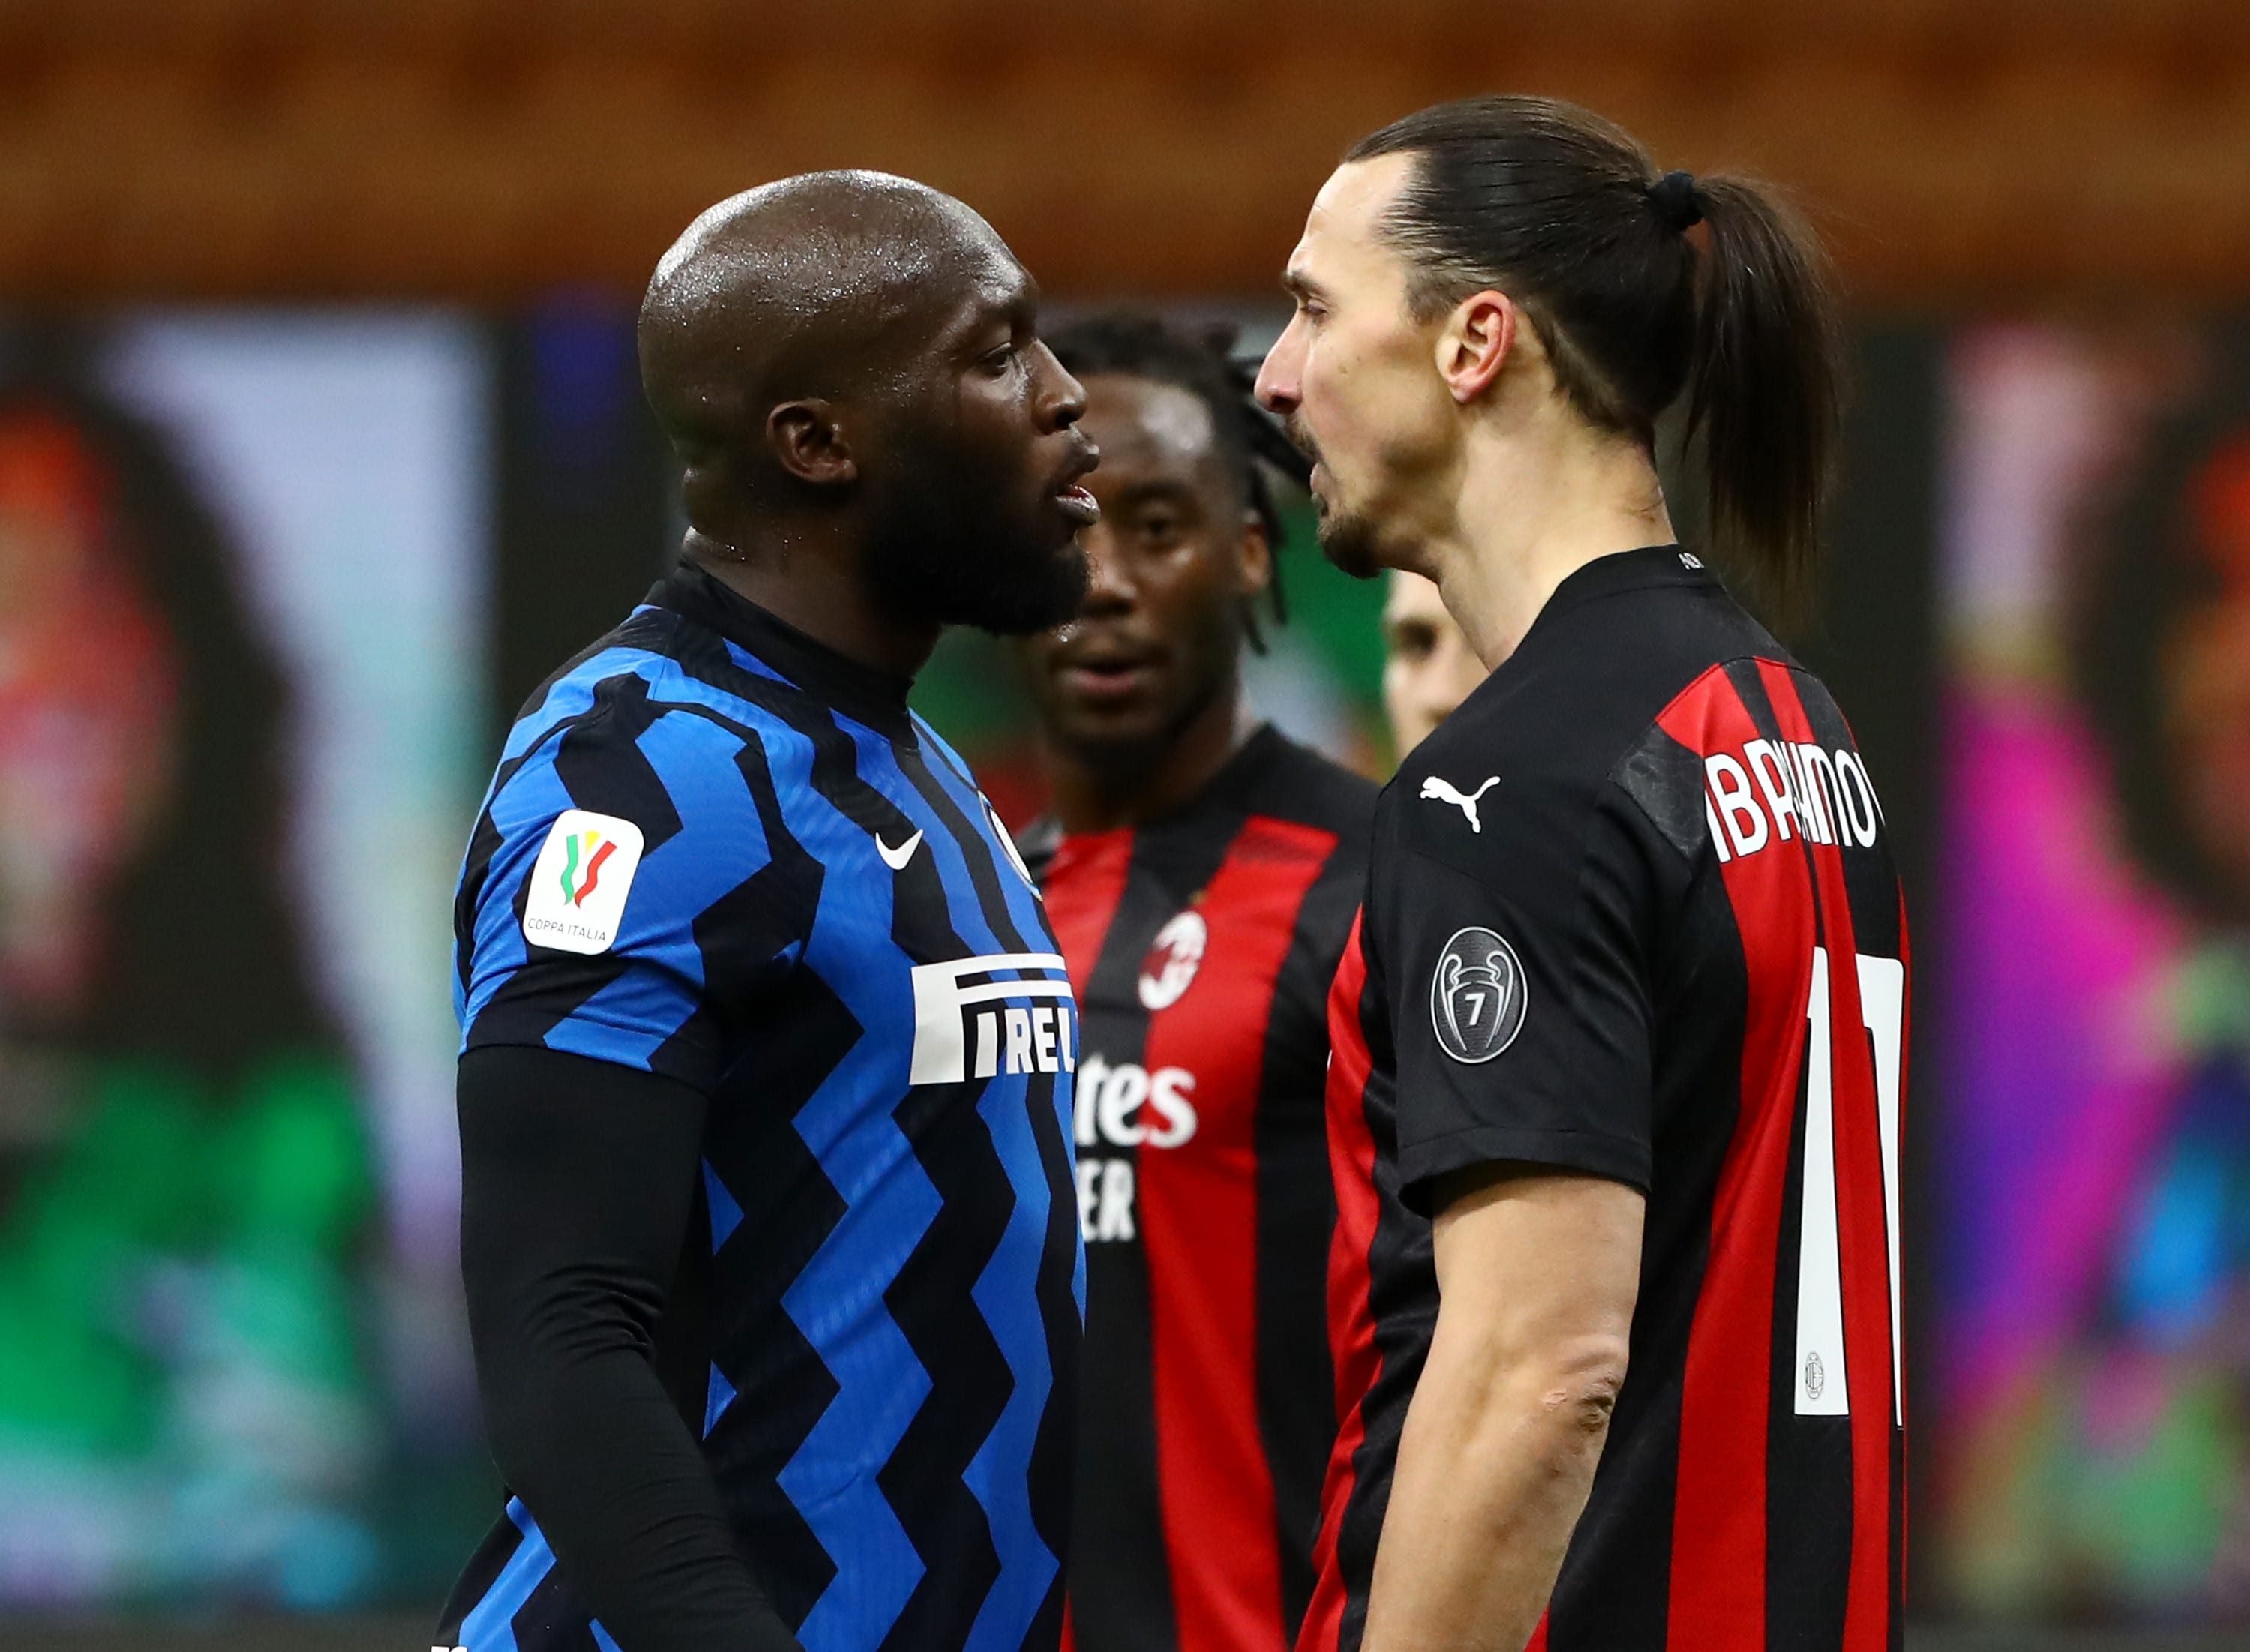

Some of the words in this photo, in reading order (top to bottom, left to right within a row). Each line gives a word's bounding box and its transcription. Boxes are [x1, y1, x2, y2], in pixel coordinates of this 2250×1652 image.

[528, 918, 563, 934] COPPA
[568, 925, 605, 941] ITALIA
[909, 952, 1077, 1084] PIREL
[1465, 992, 1486, 1026] 7
[1794, 946, 1902, 1427] 11
